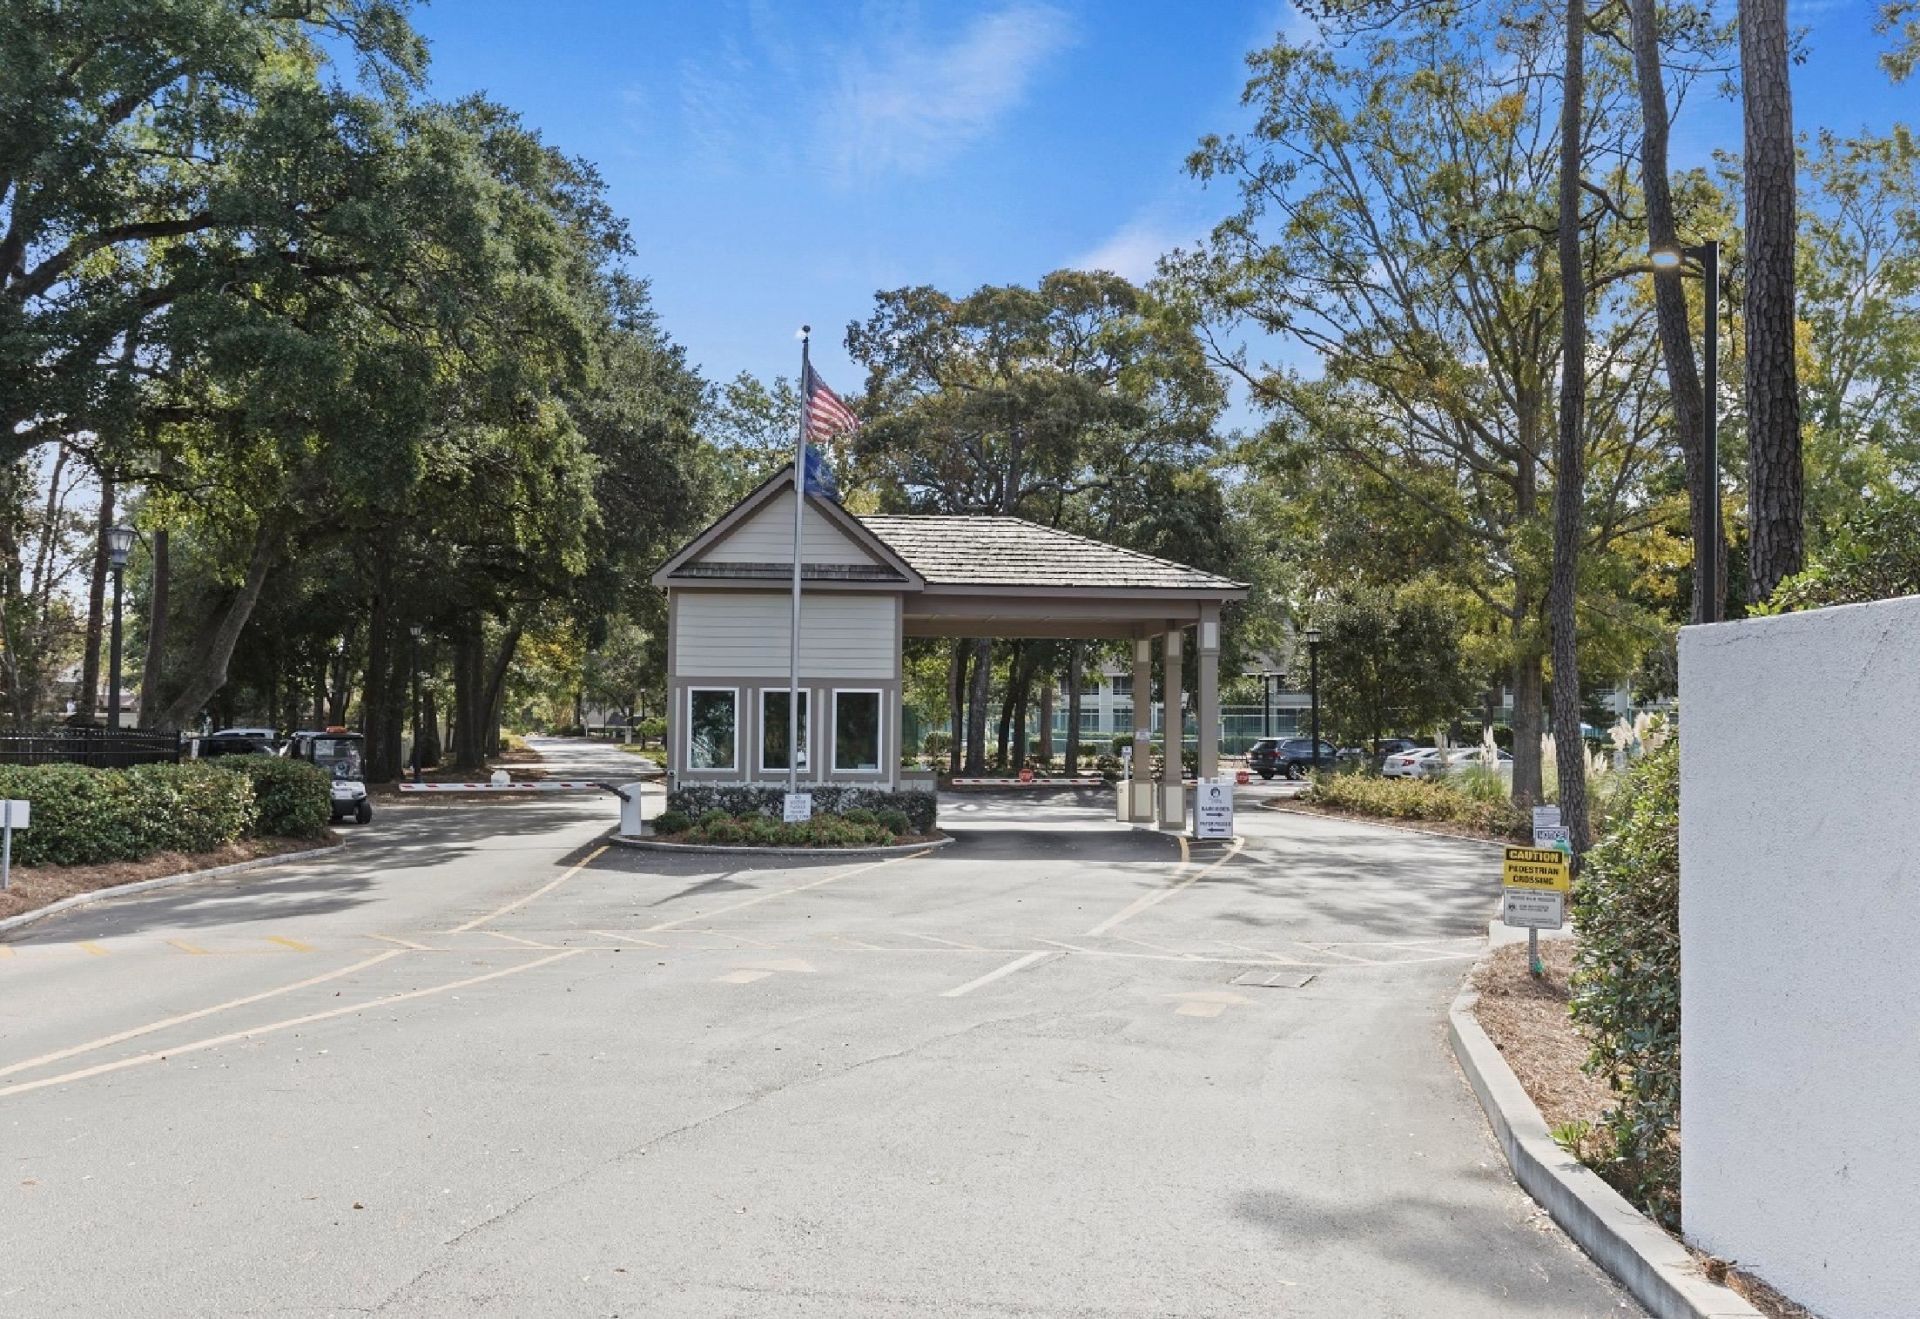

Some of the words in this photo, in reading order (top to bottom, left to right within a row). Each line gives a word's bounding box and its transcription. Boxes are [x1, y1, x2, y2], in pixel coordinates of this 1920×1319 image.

[1509, 850, 1559, 863] CAUTION
[1508, 865, 1559, 875] PEDESTRIAN
[1512, 874, 1554, 885] CROSSING
